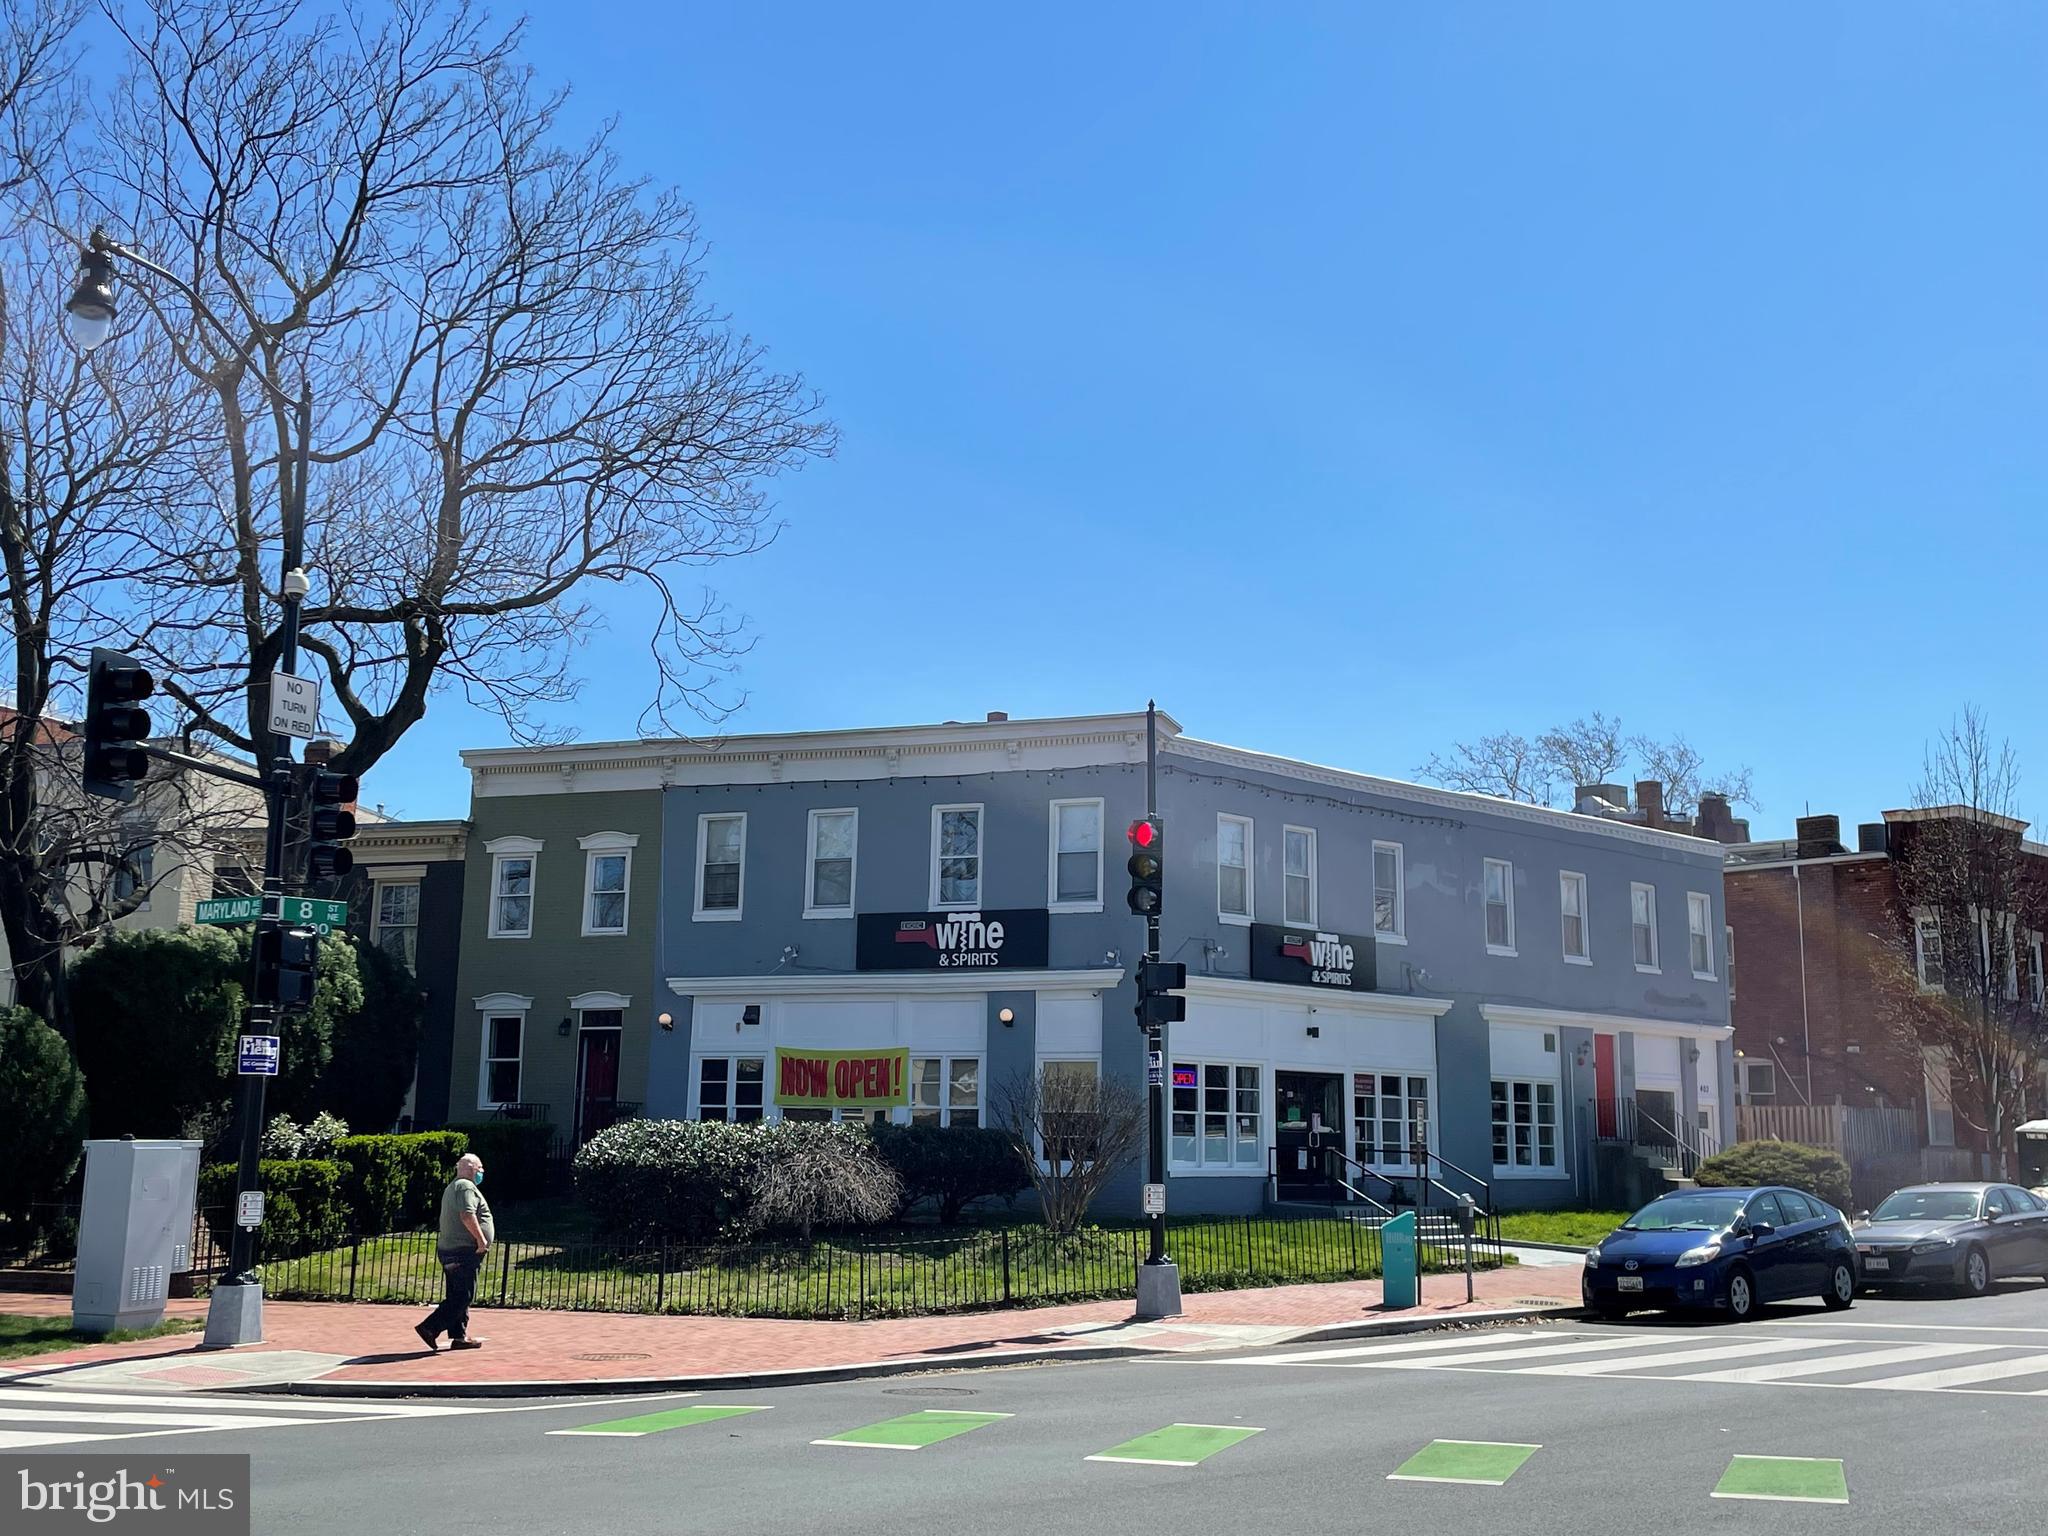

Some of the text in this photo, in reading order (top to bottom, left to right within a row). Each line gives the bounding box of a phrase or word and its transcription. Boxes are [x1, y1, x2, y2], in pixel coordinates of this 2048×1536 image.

[287, 681, 303, 695] NO
[282, 700, 307, 714] TURN
[273, 716, 311, 733] ON RED
[199, 901, 250, 920] MARYLAND
[300, 902, 339, 918] 8 ST
[327, 913, 339, 921] NE
[939, 952, 998, 966] & SPIRITS
[1312, 970, 1351, 985] & SPIRITS
[780, 1057, 829, 1098] NOW
[1173, 1072, 1194, 1084] OPEN
